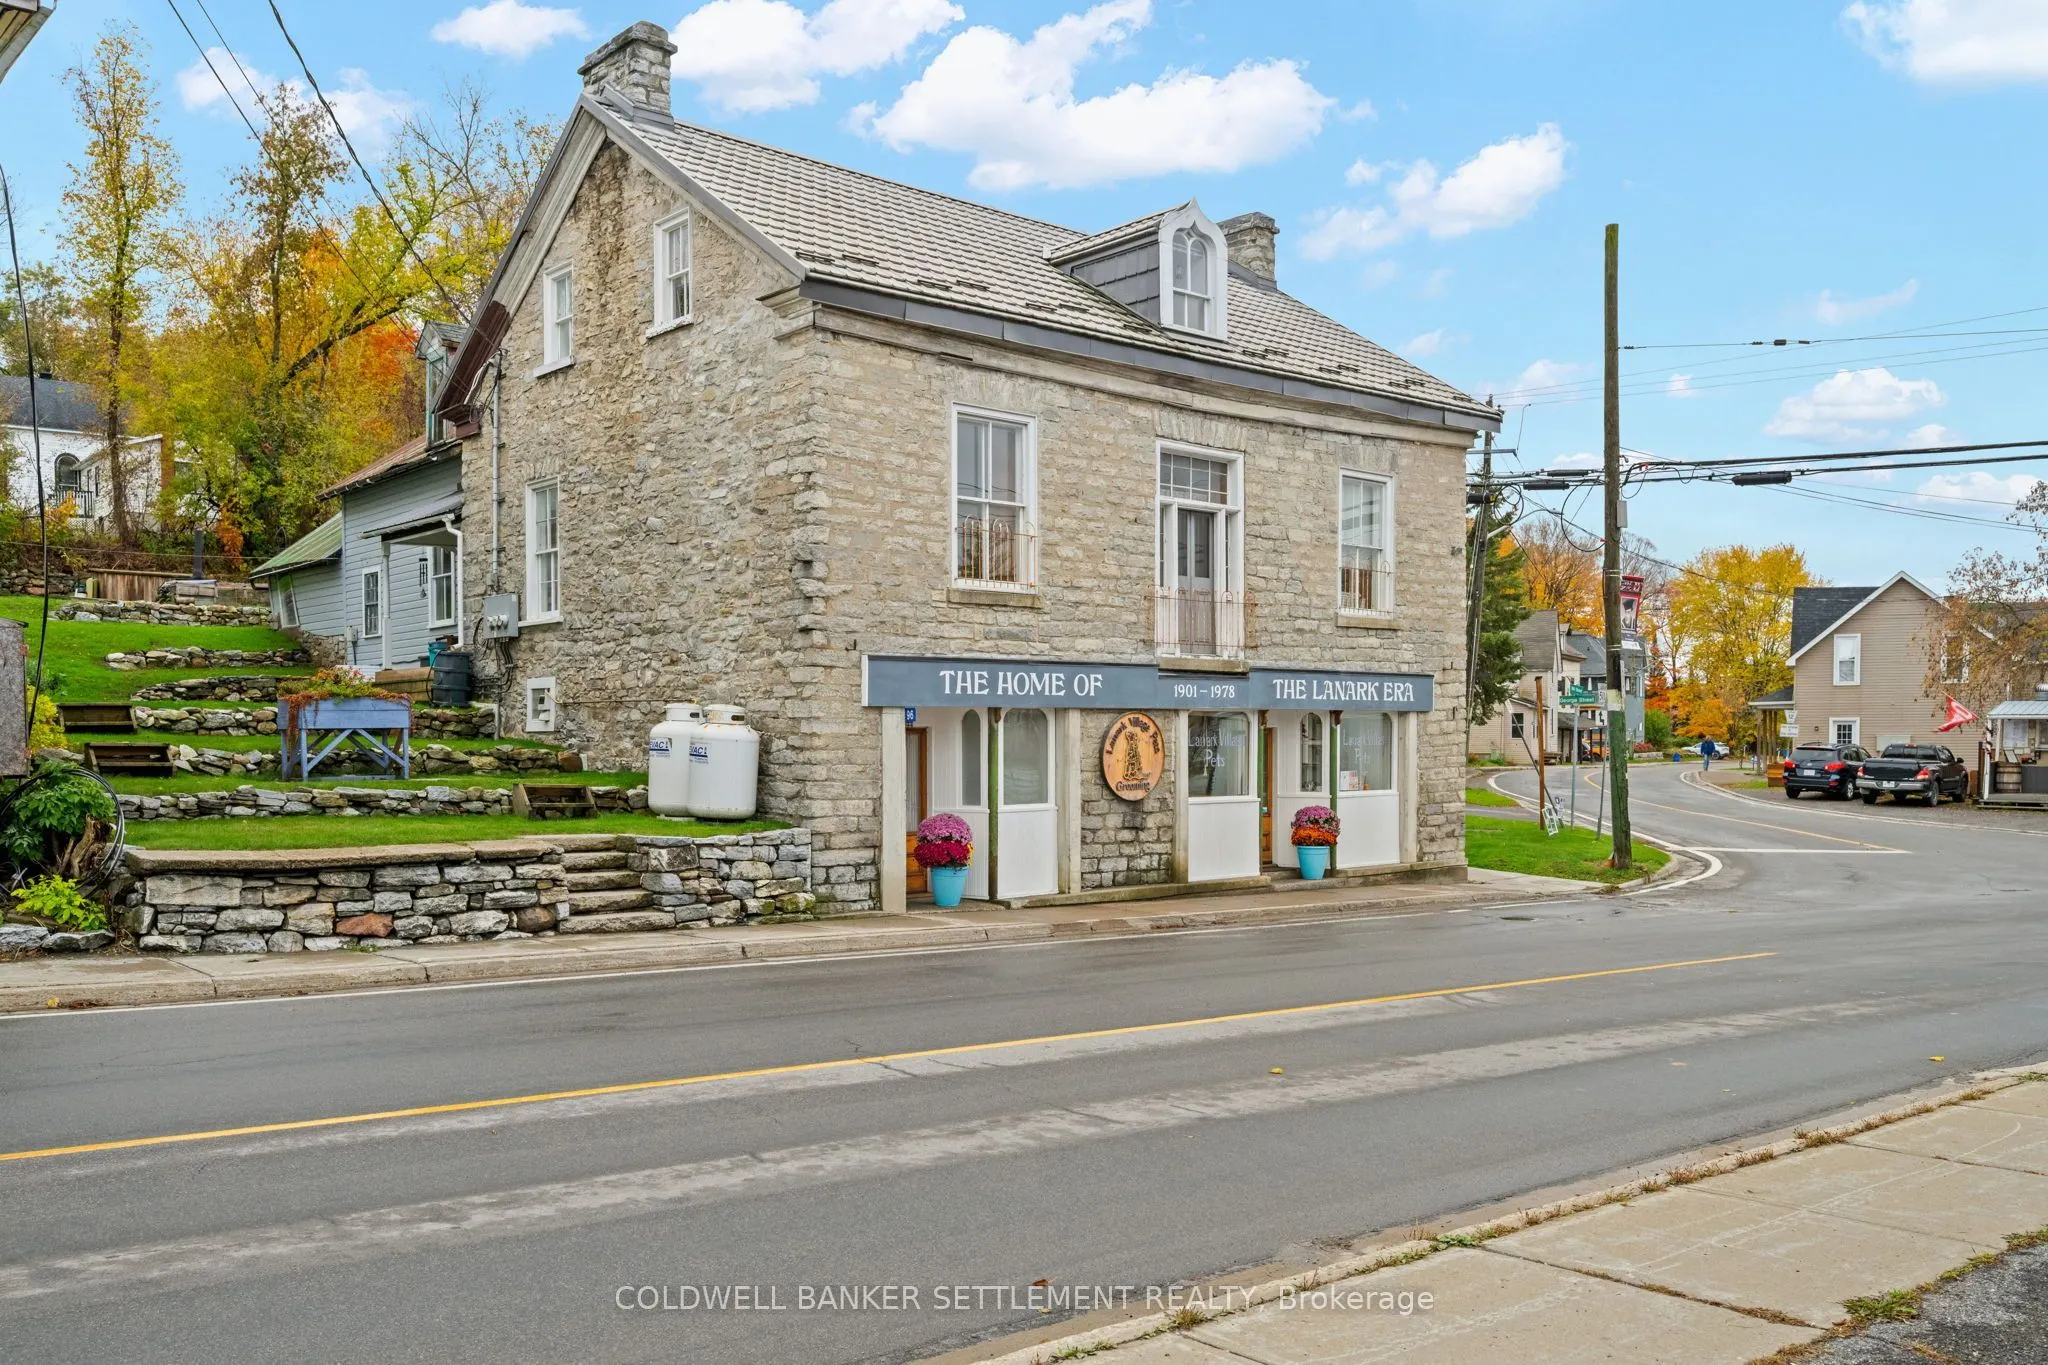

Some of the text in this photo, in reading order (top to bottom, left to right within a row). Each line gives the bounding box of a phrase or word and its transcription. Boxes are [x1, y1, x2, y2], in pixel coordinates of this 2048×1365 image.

[939, 670, 1103, 697] THE HOME OF
[1173, 684, 1197, 698] 1901
[1210, 685, 1235, 699] 1978
[1272, 679, 1415, 701] THE LANARK ERA
[1189, 729, 1218, 747] Lanark
[1205, 749, 1225, 767] Pets
